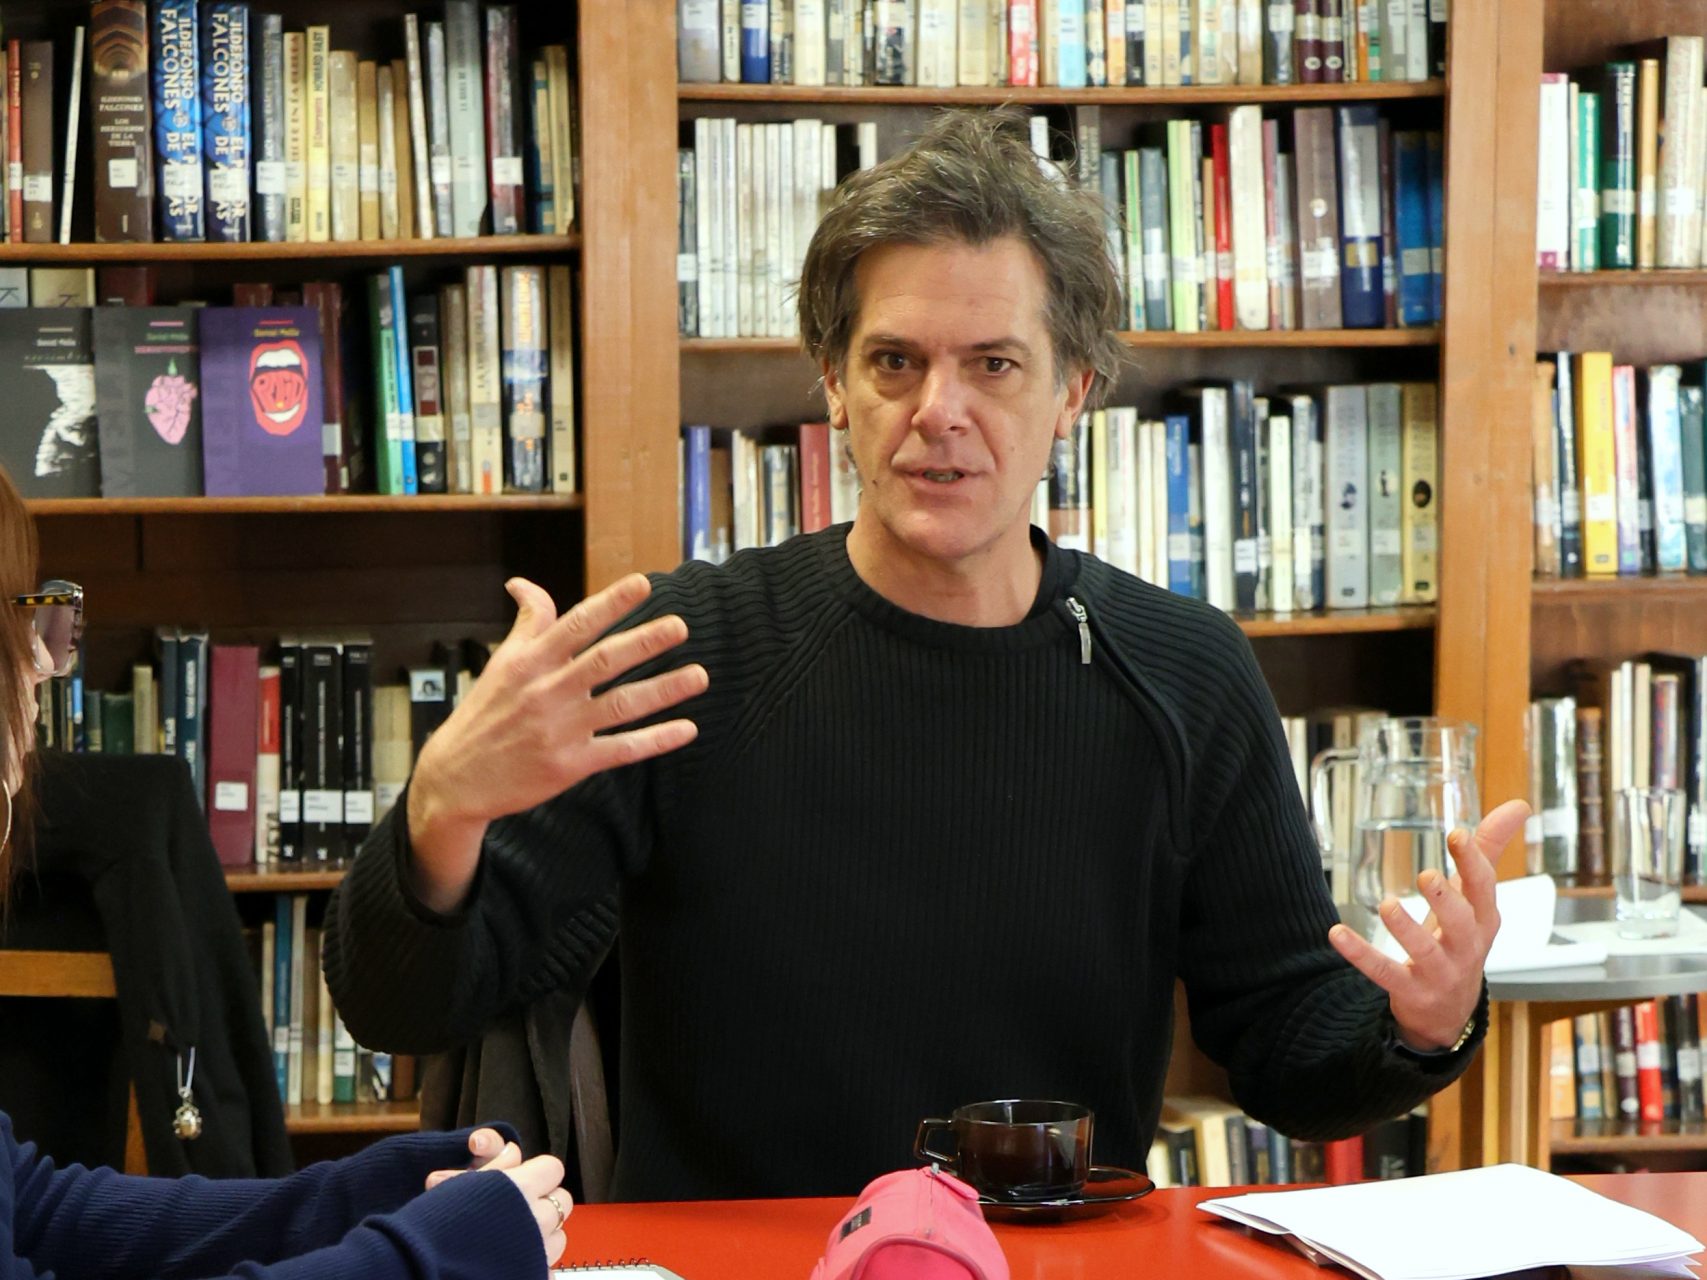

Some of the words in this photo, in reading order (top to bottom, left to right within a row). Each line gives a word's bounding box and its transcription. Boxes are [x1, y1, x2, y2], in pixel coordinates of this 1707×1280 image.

[161, 9, 180, 110] FALCONES
[178, 18, 194, 100] ILDEFONSO
[212, 13, 230, 113] FALCONES
[229, 21, 243, 103] ILDEFONSO
[313, 54, 324, 92] HOWARD
[166, 132, 180, 151] DE
[181, 132, 195, 150] EL
[215, 136, 229, 156] DE
[229, 136, 244, 153] EL
